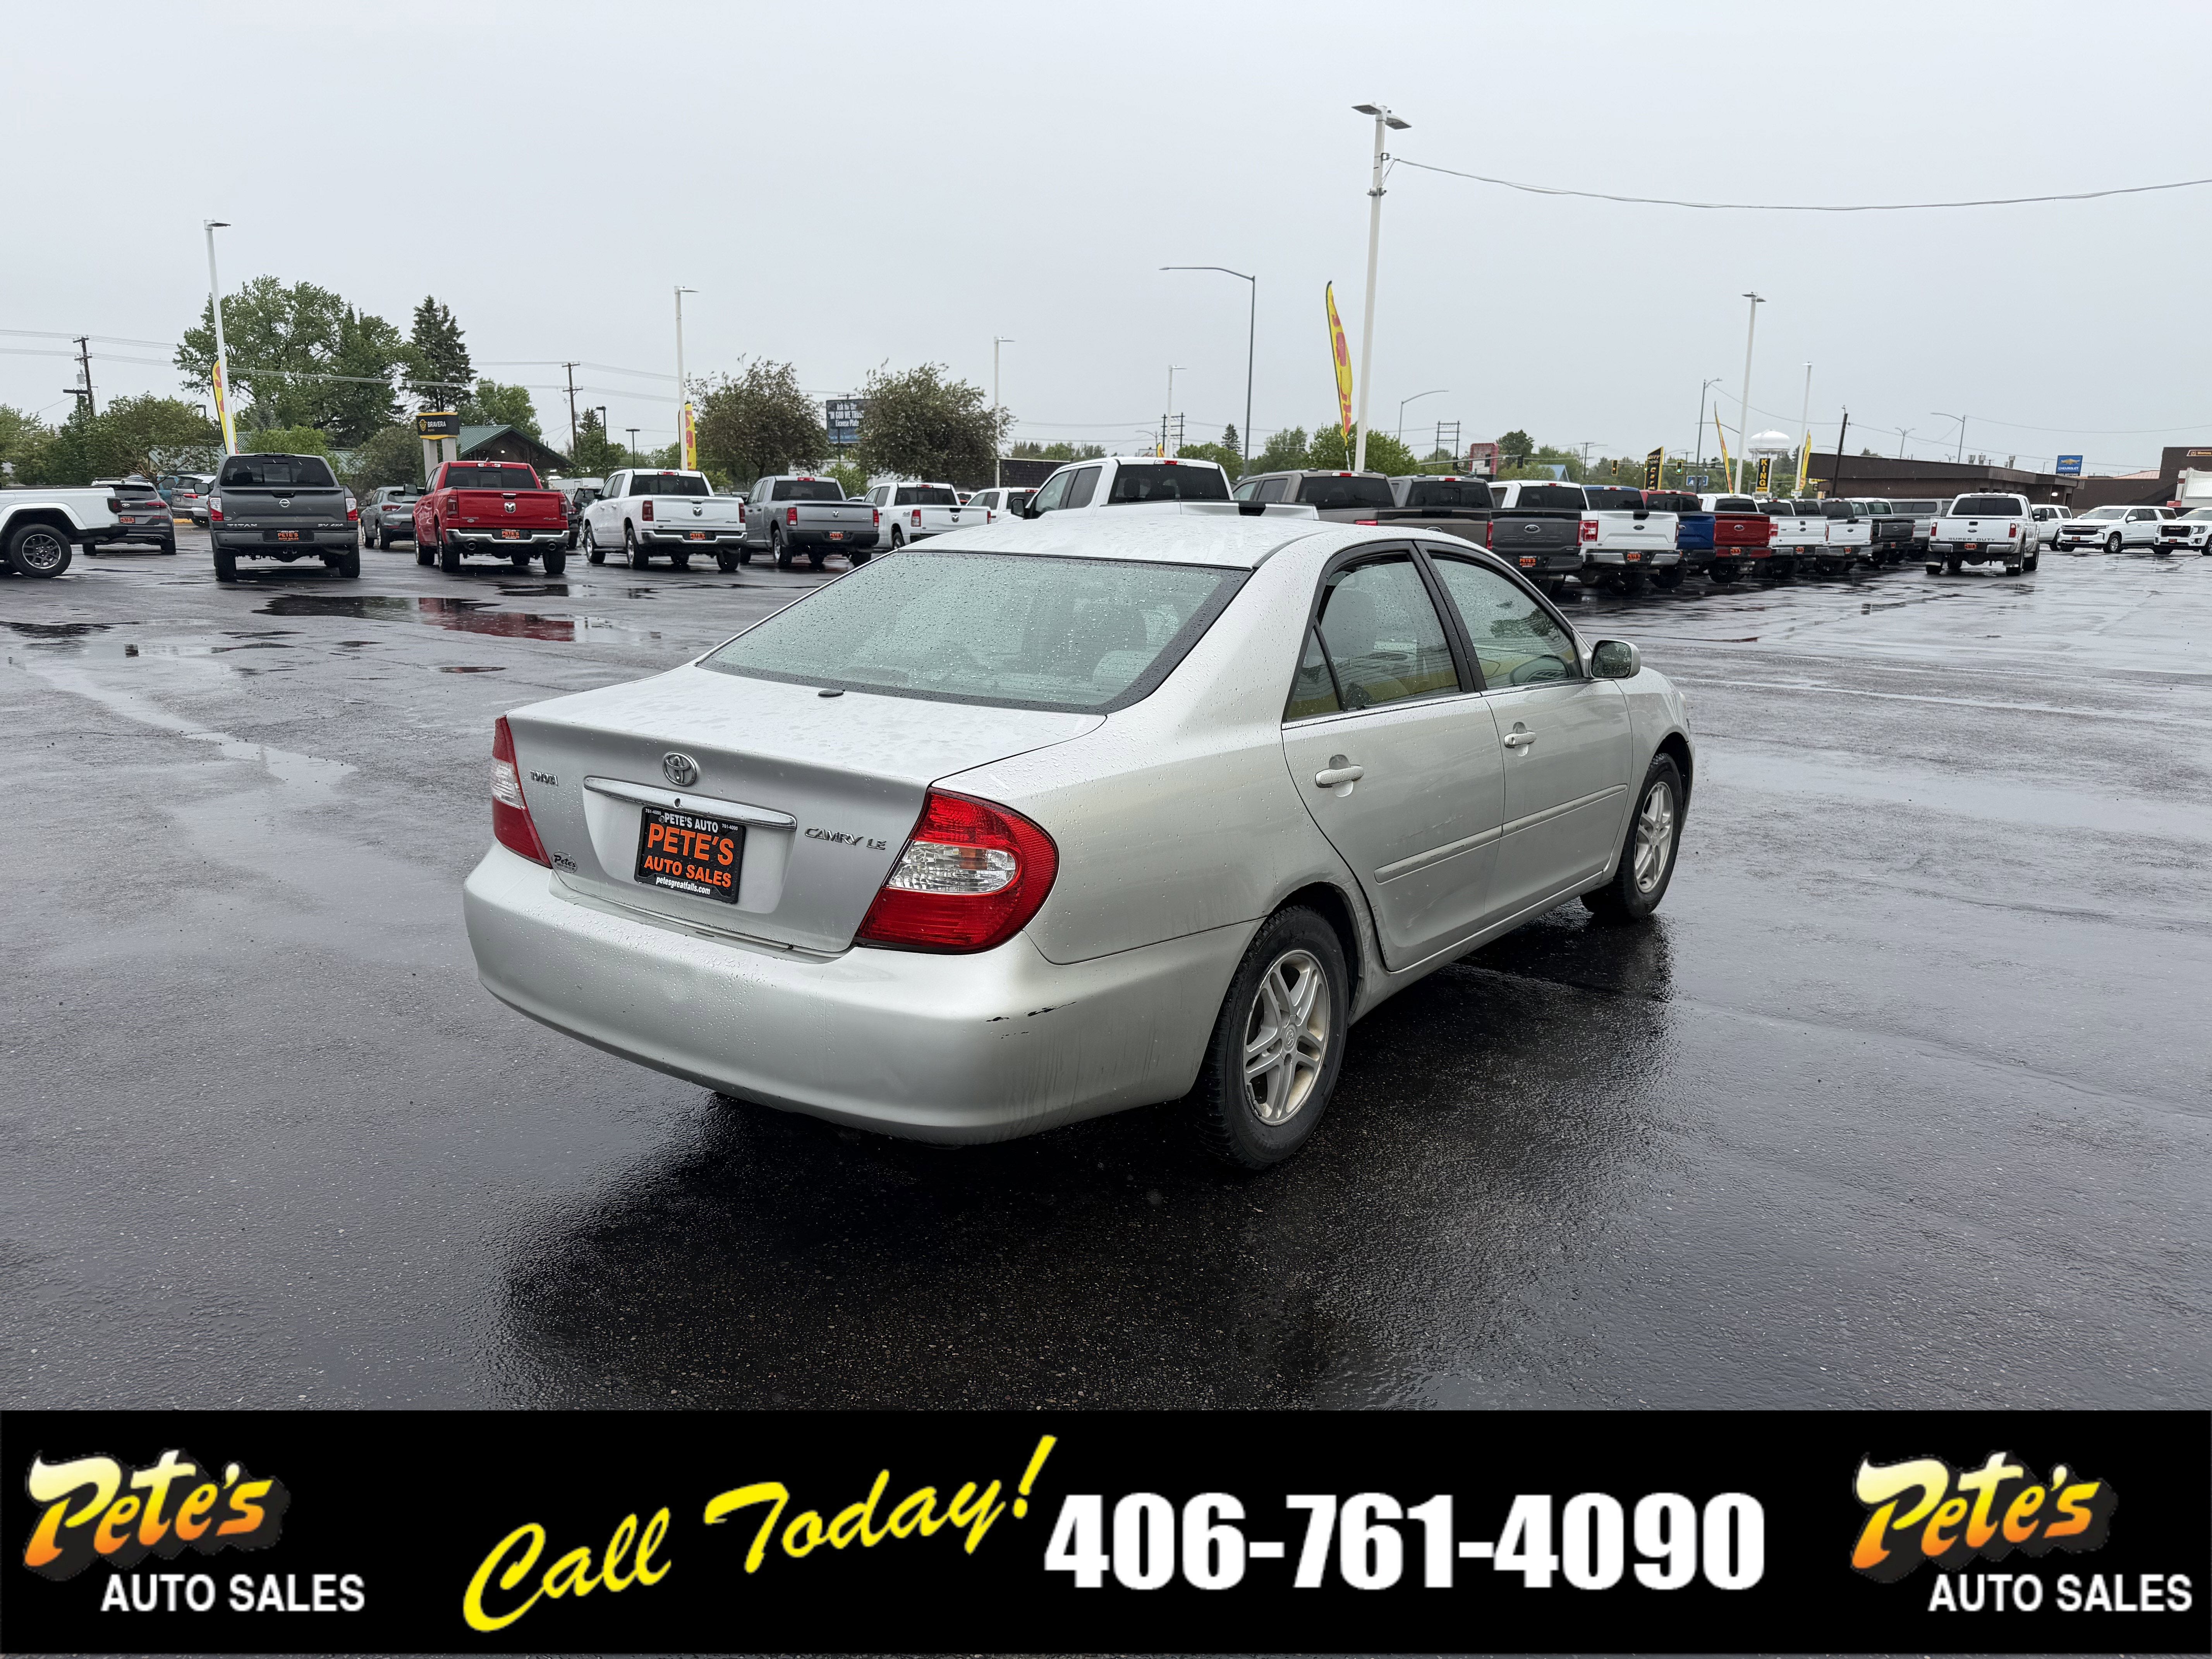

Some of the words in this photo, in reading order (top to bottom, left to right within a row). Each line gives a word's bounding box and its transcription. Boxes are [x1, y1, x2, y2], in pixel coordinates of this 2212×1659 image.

[1759, 459, 1768, 487] KING
[530, 770, 559, 786] TOYOTA
[664, 812, 692, 828] PETE'S
[695, 819, 718, 833] AUTO
[647, 823, 734, 866] PETE'S
[804, 827, 864, 846] CAMRY
[866, 838, 887, 850] LE
[644, 855, 682, 876] AUTO
[686, 864, 732, 888] SALES
[656, 876, 711, 895] petesgreatfalls.com
